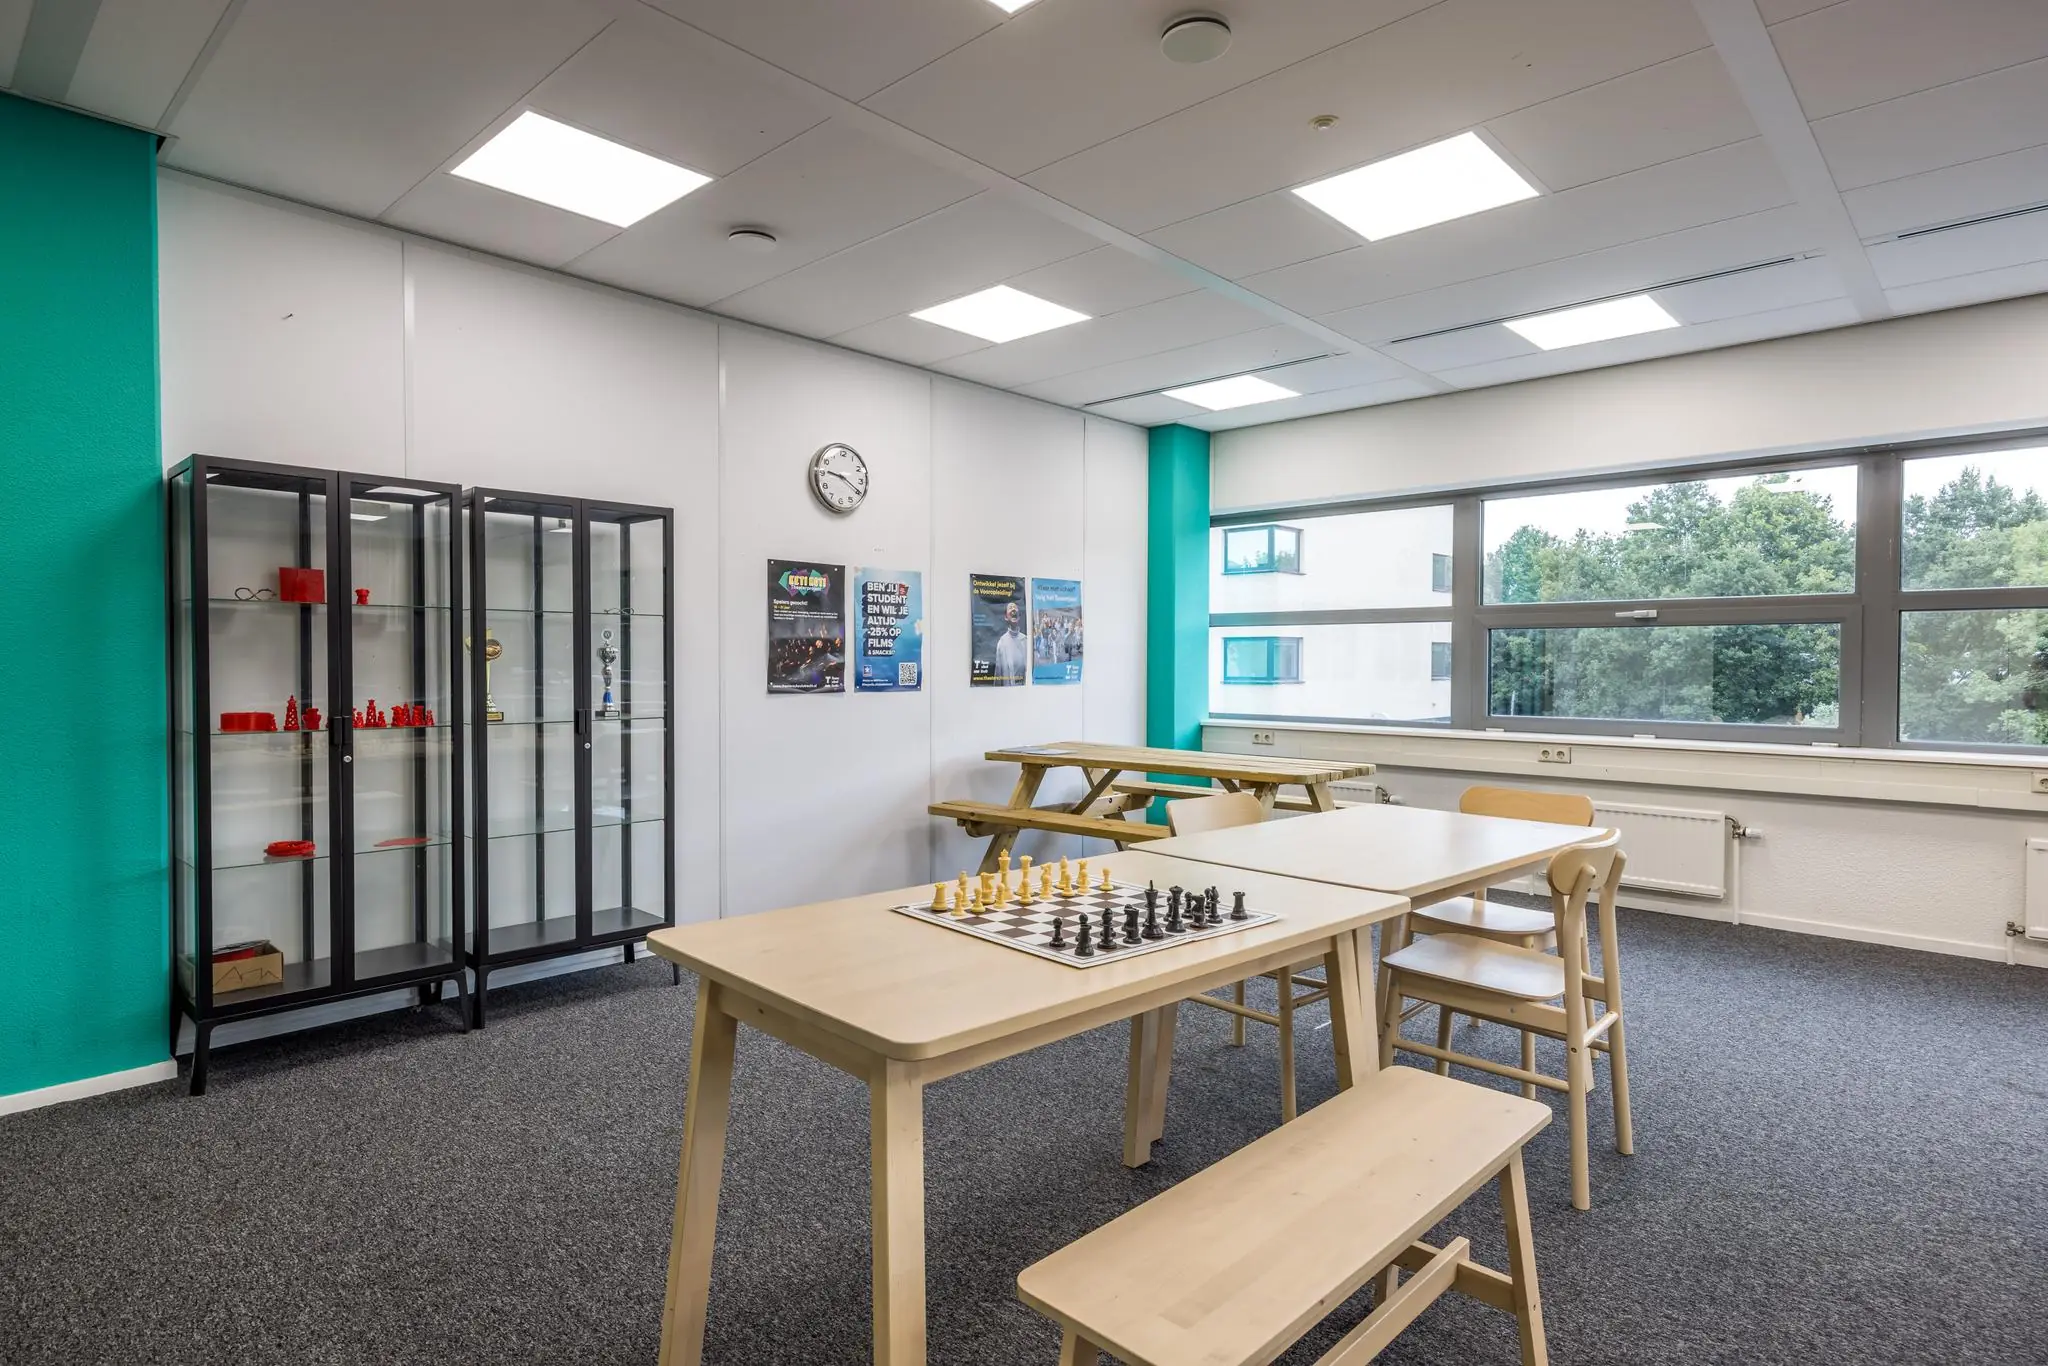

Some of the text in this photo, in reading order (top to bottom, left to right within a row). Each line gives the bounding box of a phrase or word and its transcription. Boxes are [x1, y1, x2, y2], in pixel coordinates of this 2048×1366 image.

[867, 582, 898, 593] BEN JIJ
[867, 593, 907, 604] STUDENT
[867, 605, 909, 615] EN WIL JE
[867, 616, 896, 626] ALTIJD
[867, 627, 901, 637] -25% OP
[868, 639, 894, 648] FILMS
